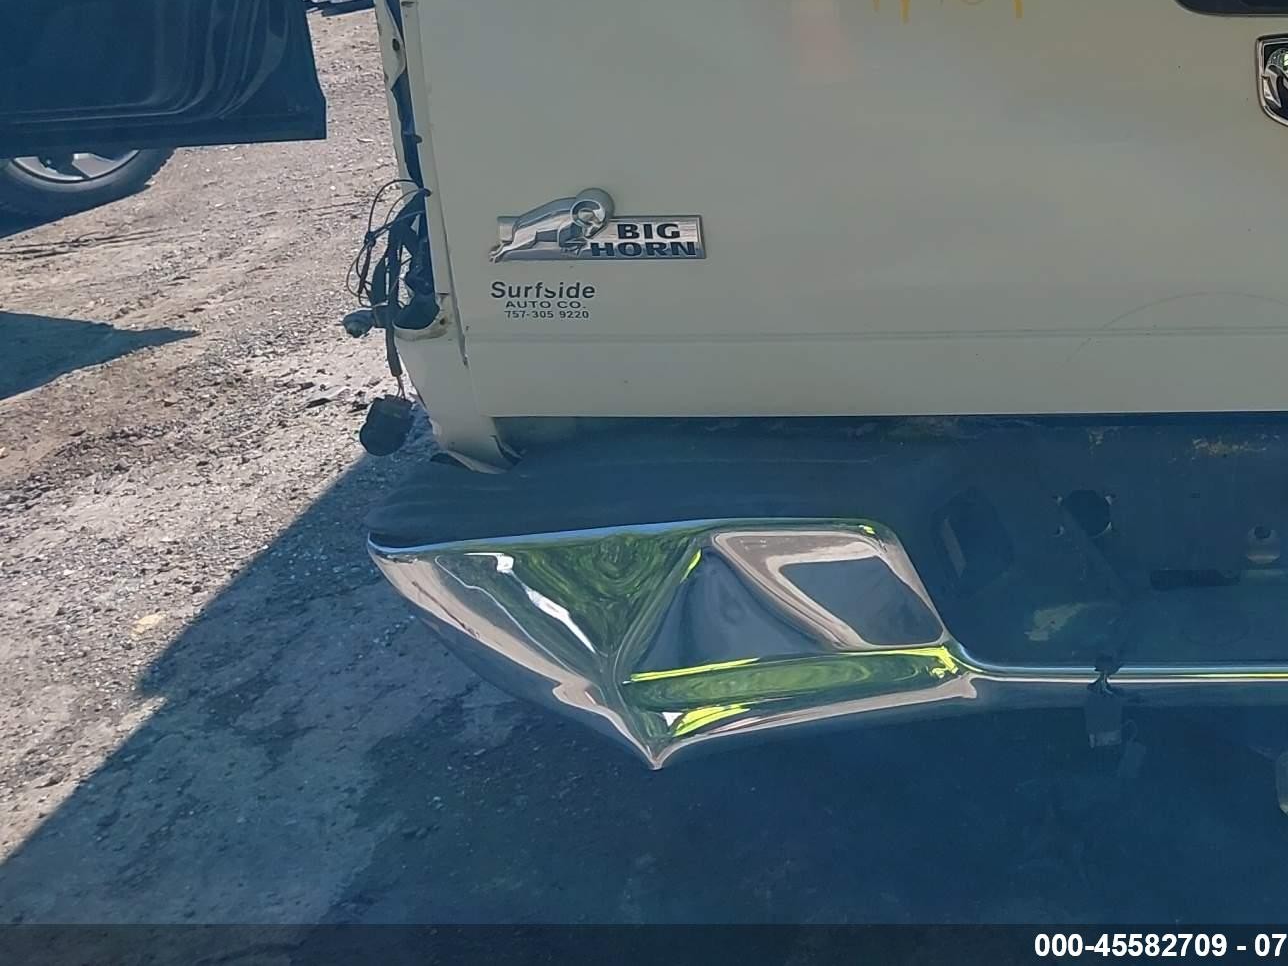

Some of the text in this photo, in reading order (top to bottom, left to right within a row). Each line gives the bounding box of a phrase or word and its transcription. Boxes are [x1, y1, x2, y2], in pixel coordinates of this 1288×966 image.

[617, 223, 680, 240] BIG
[591, 241, 696, 257] HORN
[490, 281, 596, 299] Surfside
[505, 300, 587, 309] AUTO CO.
[504, 310, 590, 319] 757-305 9220
